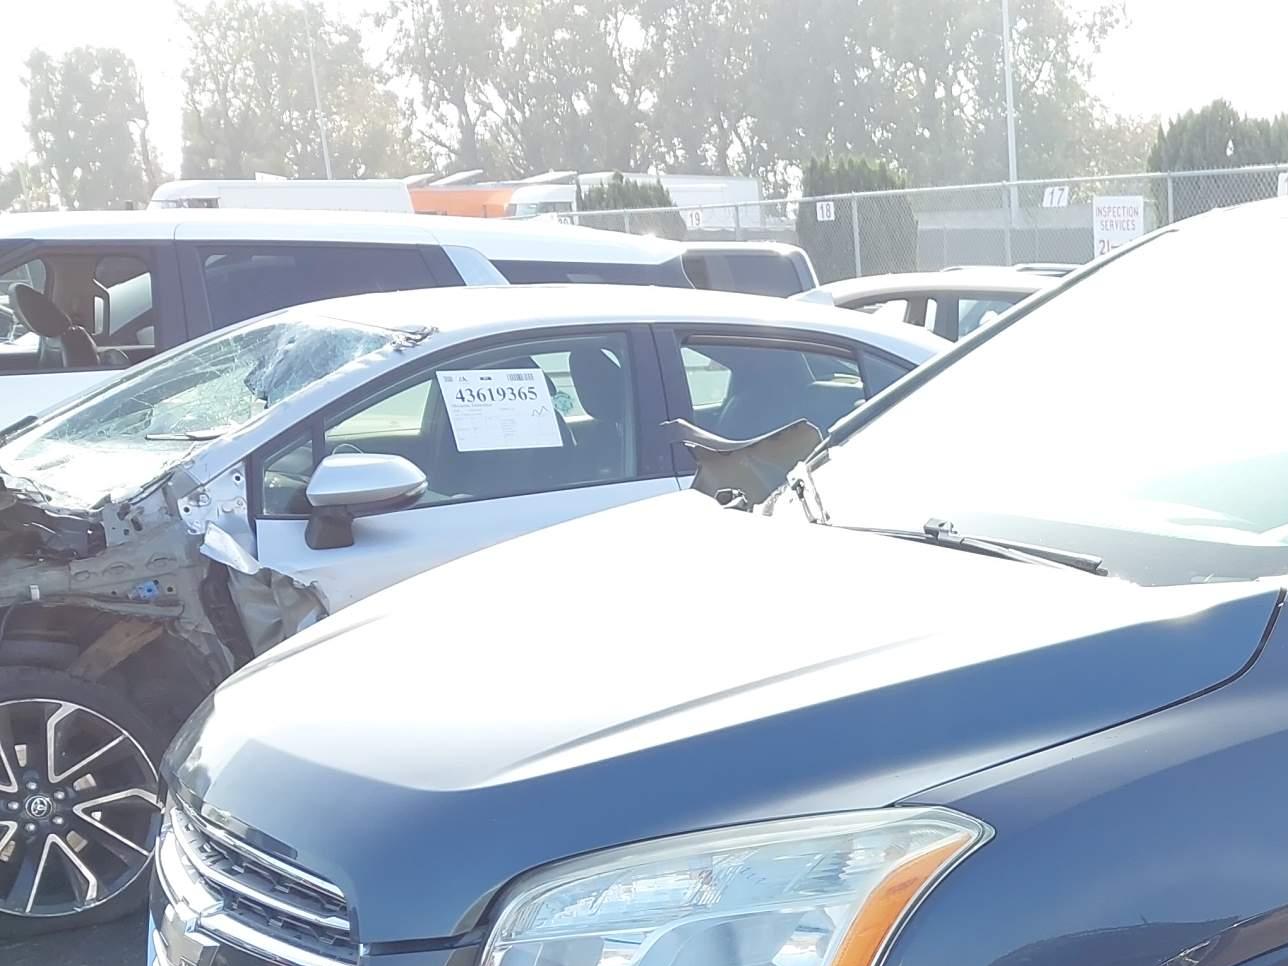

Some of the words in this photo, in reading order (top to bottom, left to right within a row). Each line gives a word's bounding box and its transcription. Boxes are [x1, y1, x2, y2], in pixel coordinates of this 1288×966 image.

[1049, 187, 1065, 206] 17
[689, 211, 701, 226] 19
[820, 202, 832, 219] 18
[1095, 206, 1140, 218] INSPECTION
[1099, 219, 1137, 232] SERVICES
[455, 386, 539, 404] 43619365
